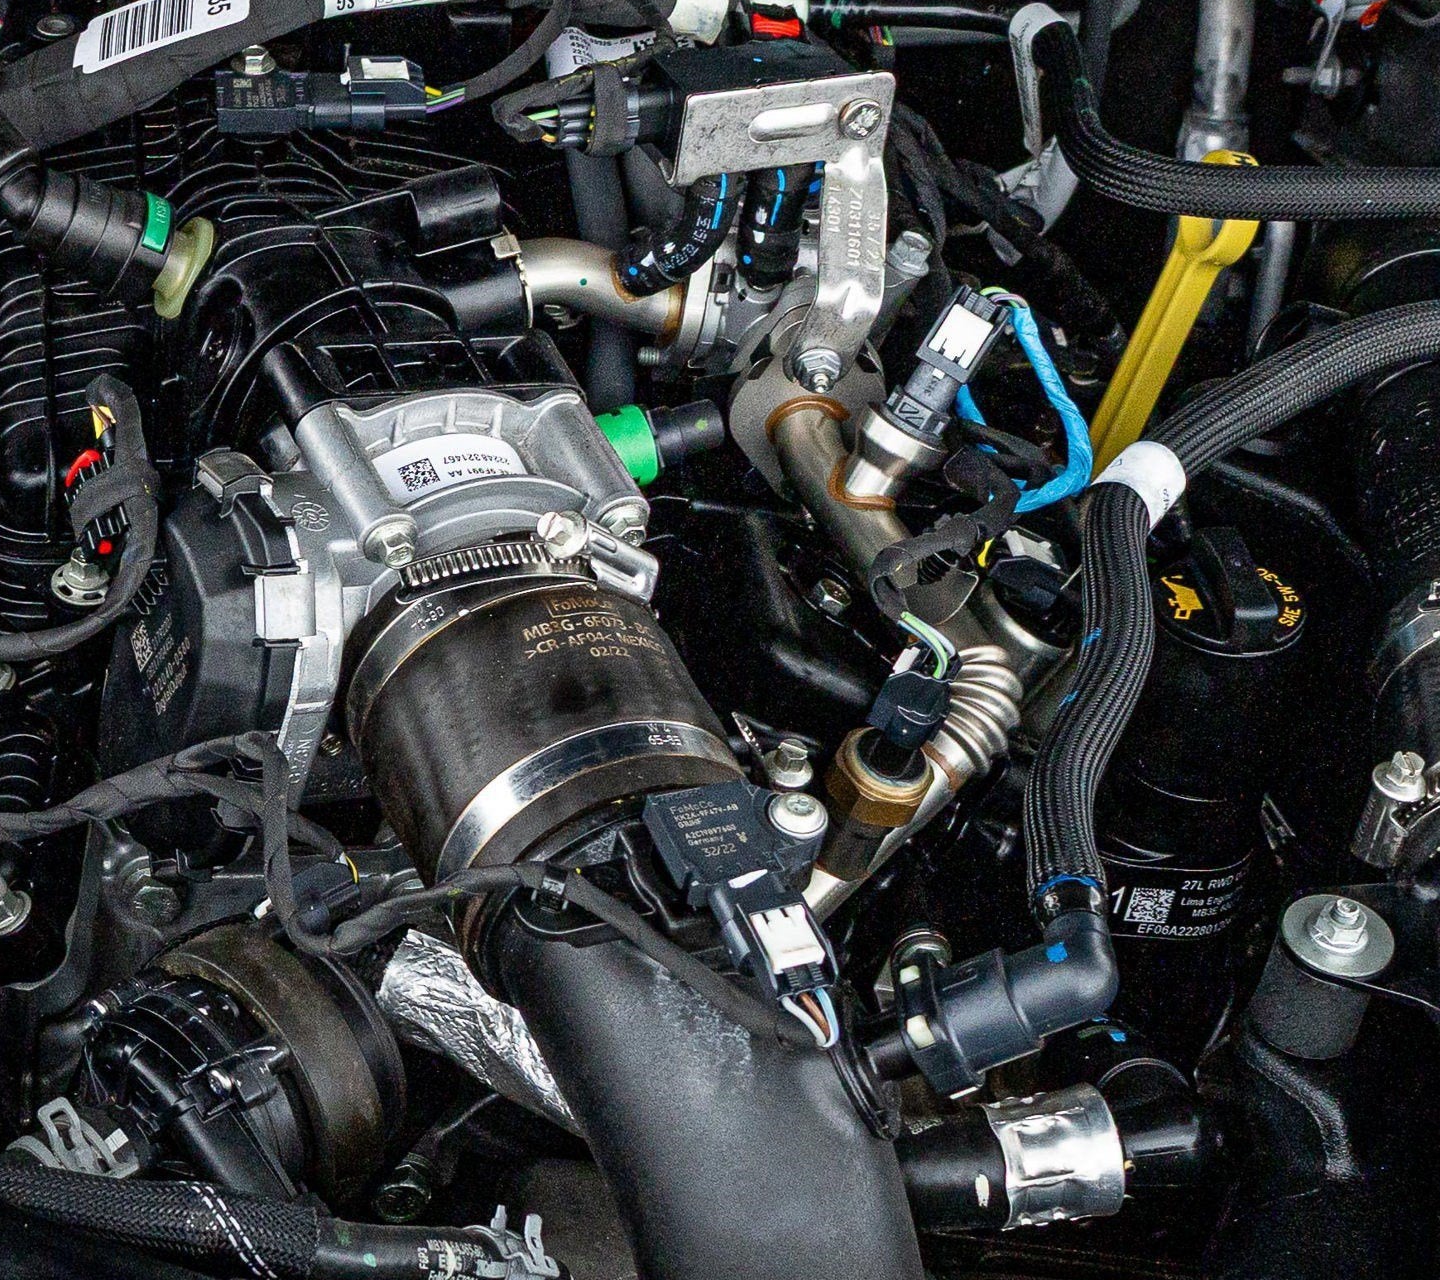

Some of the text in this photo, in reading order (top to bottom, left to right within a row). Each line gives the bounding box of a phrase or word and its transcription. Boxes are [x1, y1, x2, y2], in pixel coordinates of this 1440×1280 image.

[1279, 606, 1301, 627] SAE
[590, 646, 631, 658] 02/22
[669, 800, 715, 815] FoMoCo
[687, 835, 724, 846] Germany
[701, 842, 737, 858] 32/22
[1111, 885, 1126, 914] 1
